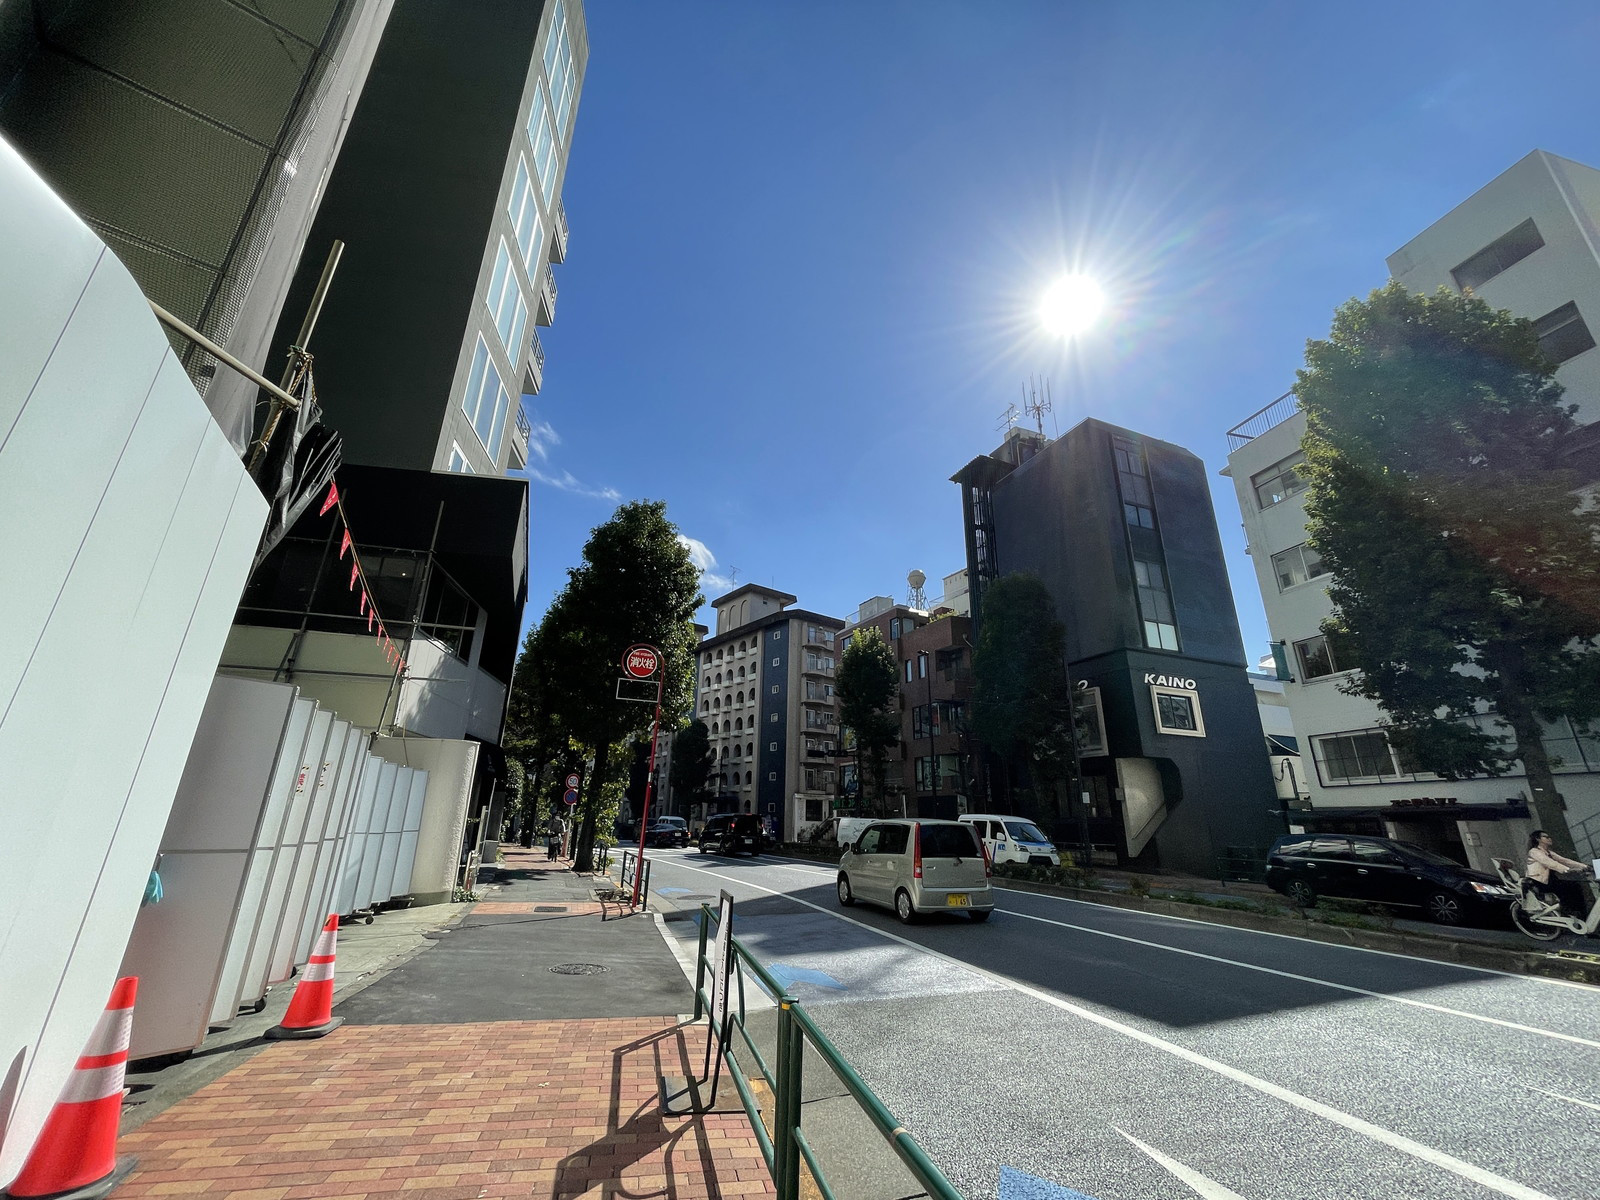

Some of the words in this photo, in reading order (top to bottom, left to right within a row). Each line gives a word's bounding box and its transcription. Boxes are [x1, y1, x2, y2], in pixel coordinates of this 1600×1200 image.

[630, 656, 655, 670] 消火栓
[1144, 673, 1197, 690] KAINO
[569, 777, 577, 785] 50
